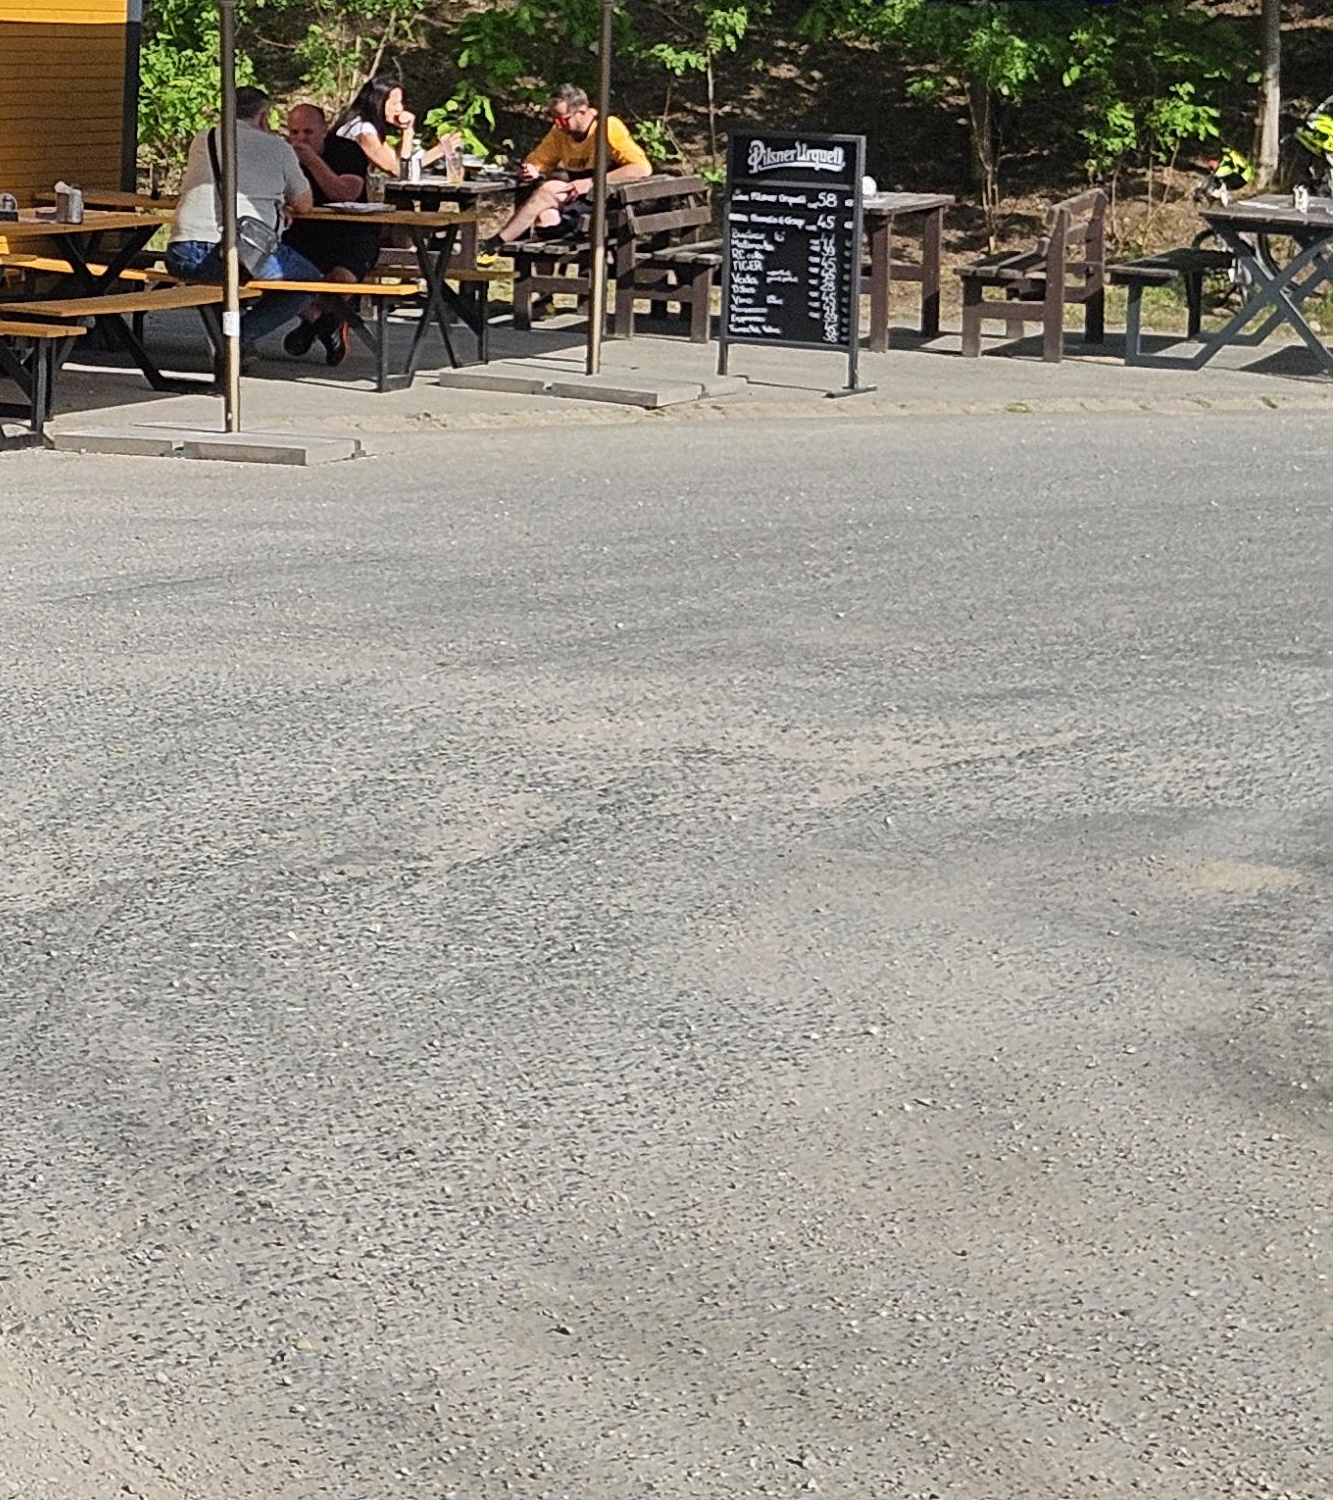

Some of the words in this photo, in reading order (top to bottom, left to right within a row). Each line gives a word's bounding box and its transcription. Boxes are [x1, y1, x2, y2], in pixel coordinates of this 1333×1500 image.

[747, 140, 797, 175] Pilsner
[795, 141, 846, 172] Urquell
[818, 192, 838, 208] 58
[817, 214, 836, 229] 45
[733, 260, 763, 271] TIGER
